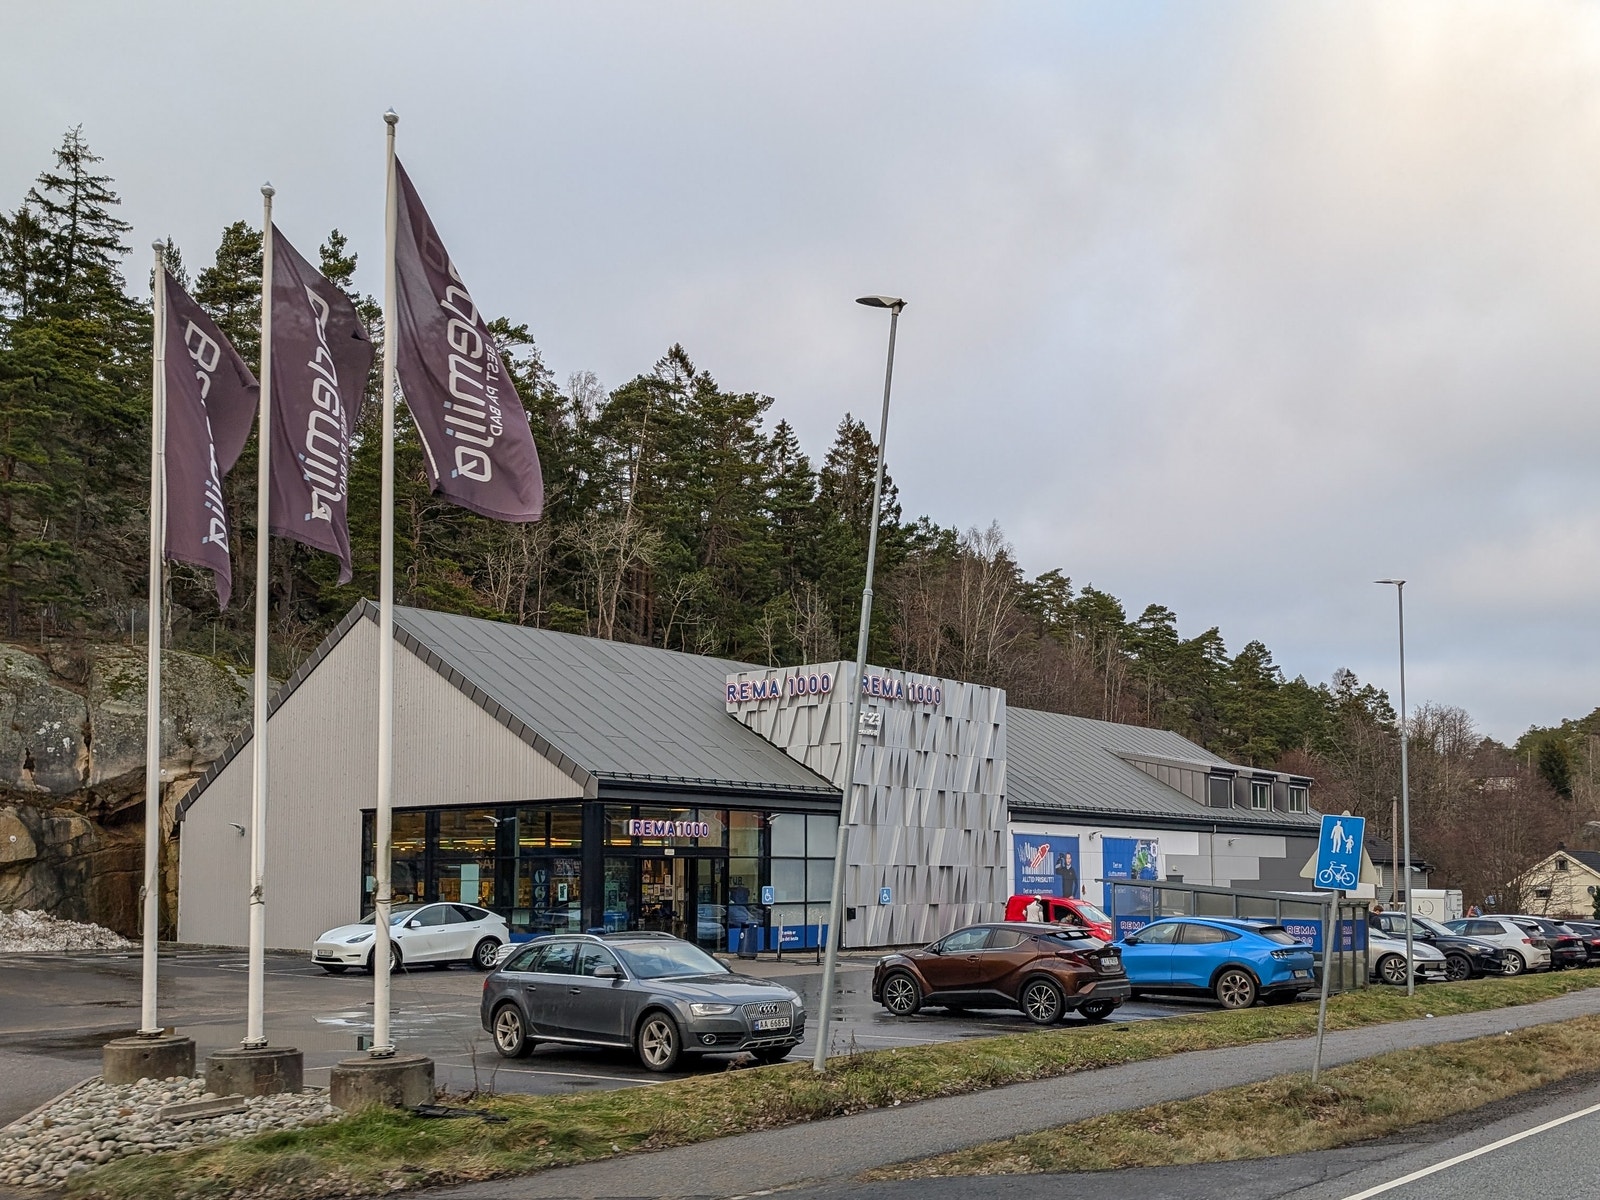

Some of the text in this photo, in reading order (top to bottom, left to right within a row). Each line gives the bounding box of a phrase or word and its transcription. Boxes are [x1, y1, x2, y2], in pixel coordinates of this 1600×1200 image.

[726, 672, 833, 702] REMA 1000
[862, 674, 942, 705] REMA 1000
[630, 819, 709, 838] REMA 1000
[1120, 921, 1146, 930] REMA
[1286, 926, 1317, 935] REMA
